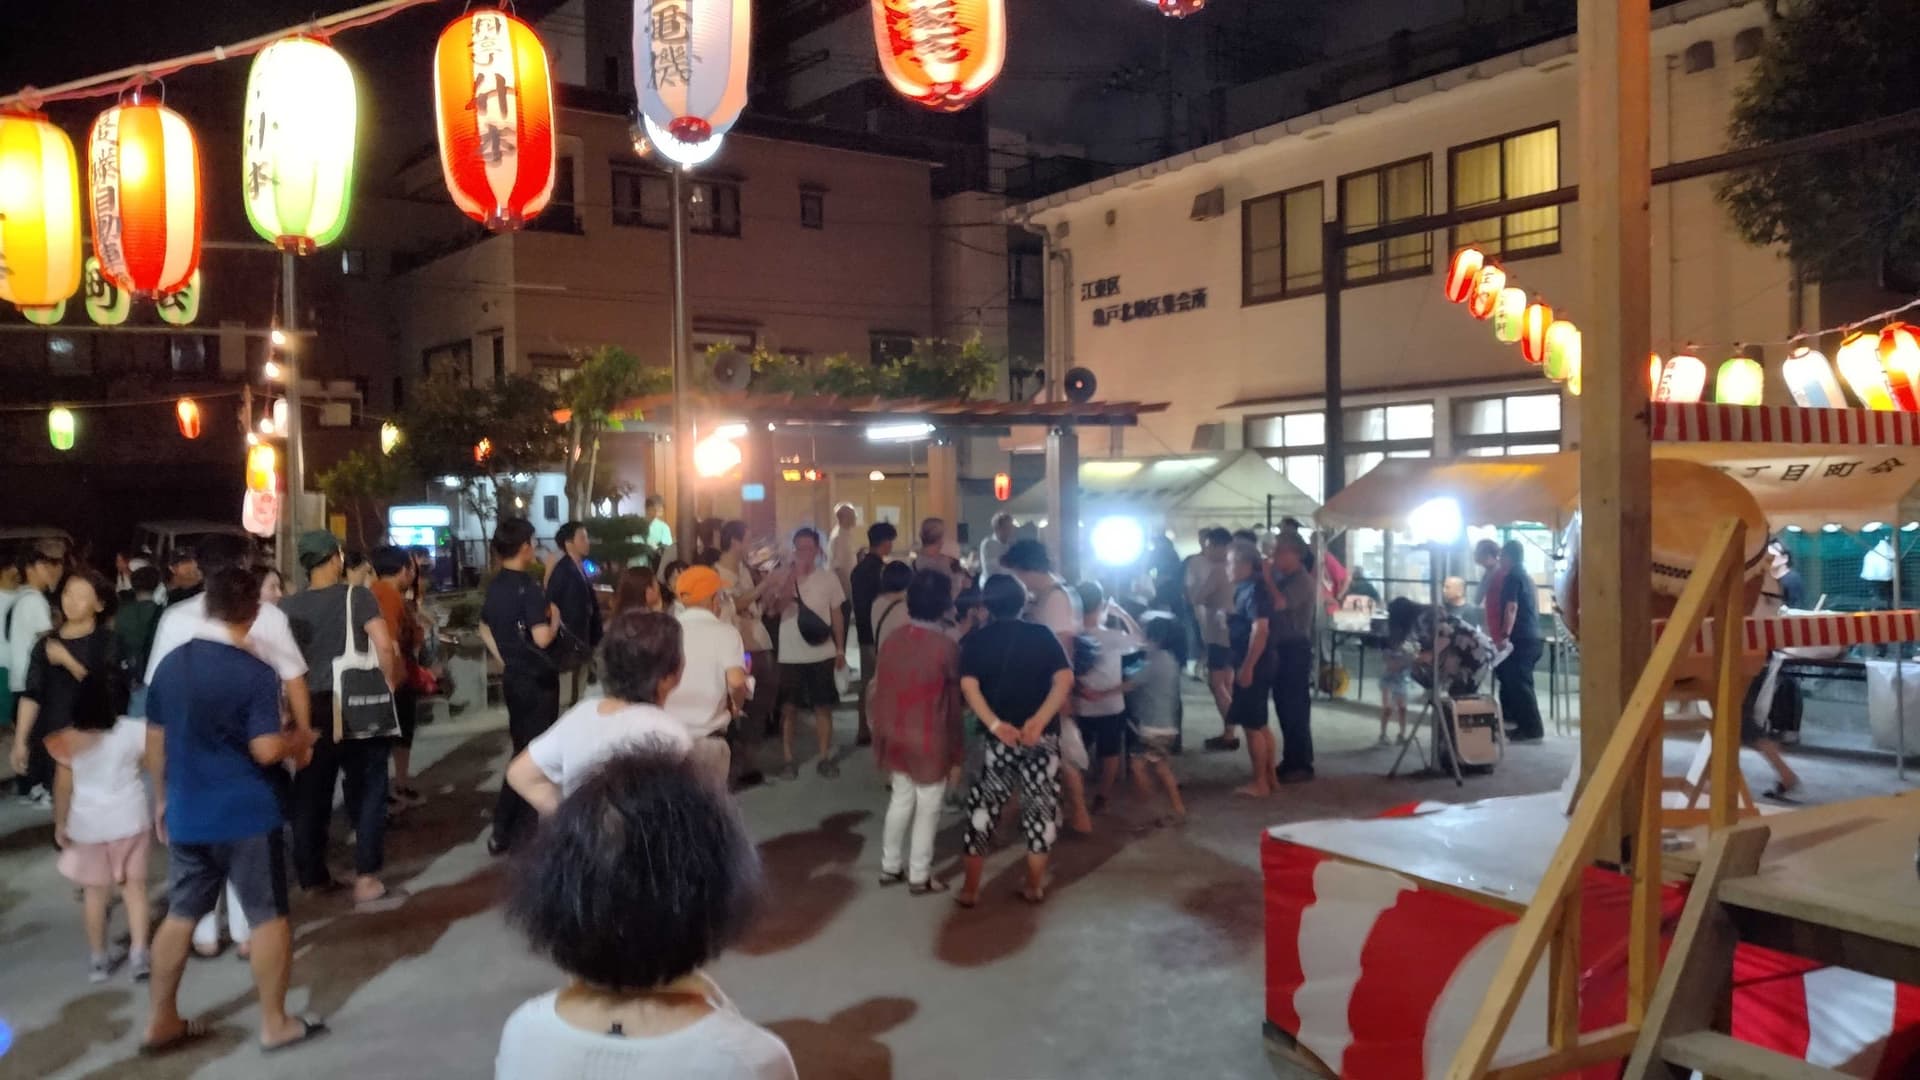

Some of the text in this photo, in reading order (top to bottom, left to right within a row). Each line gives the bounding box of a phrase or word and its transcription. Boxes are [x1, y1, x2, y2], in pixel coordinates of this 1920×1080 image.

[1081, 275, 1121, 302] 江東区
[1714, 457, 1905, 482] 丁目町会
